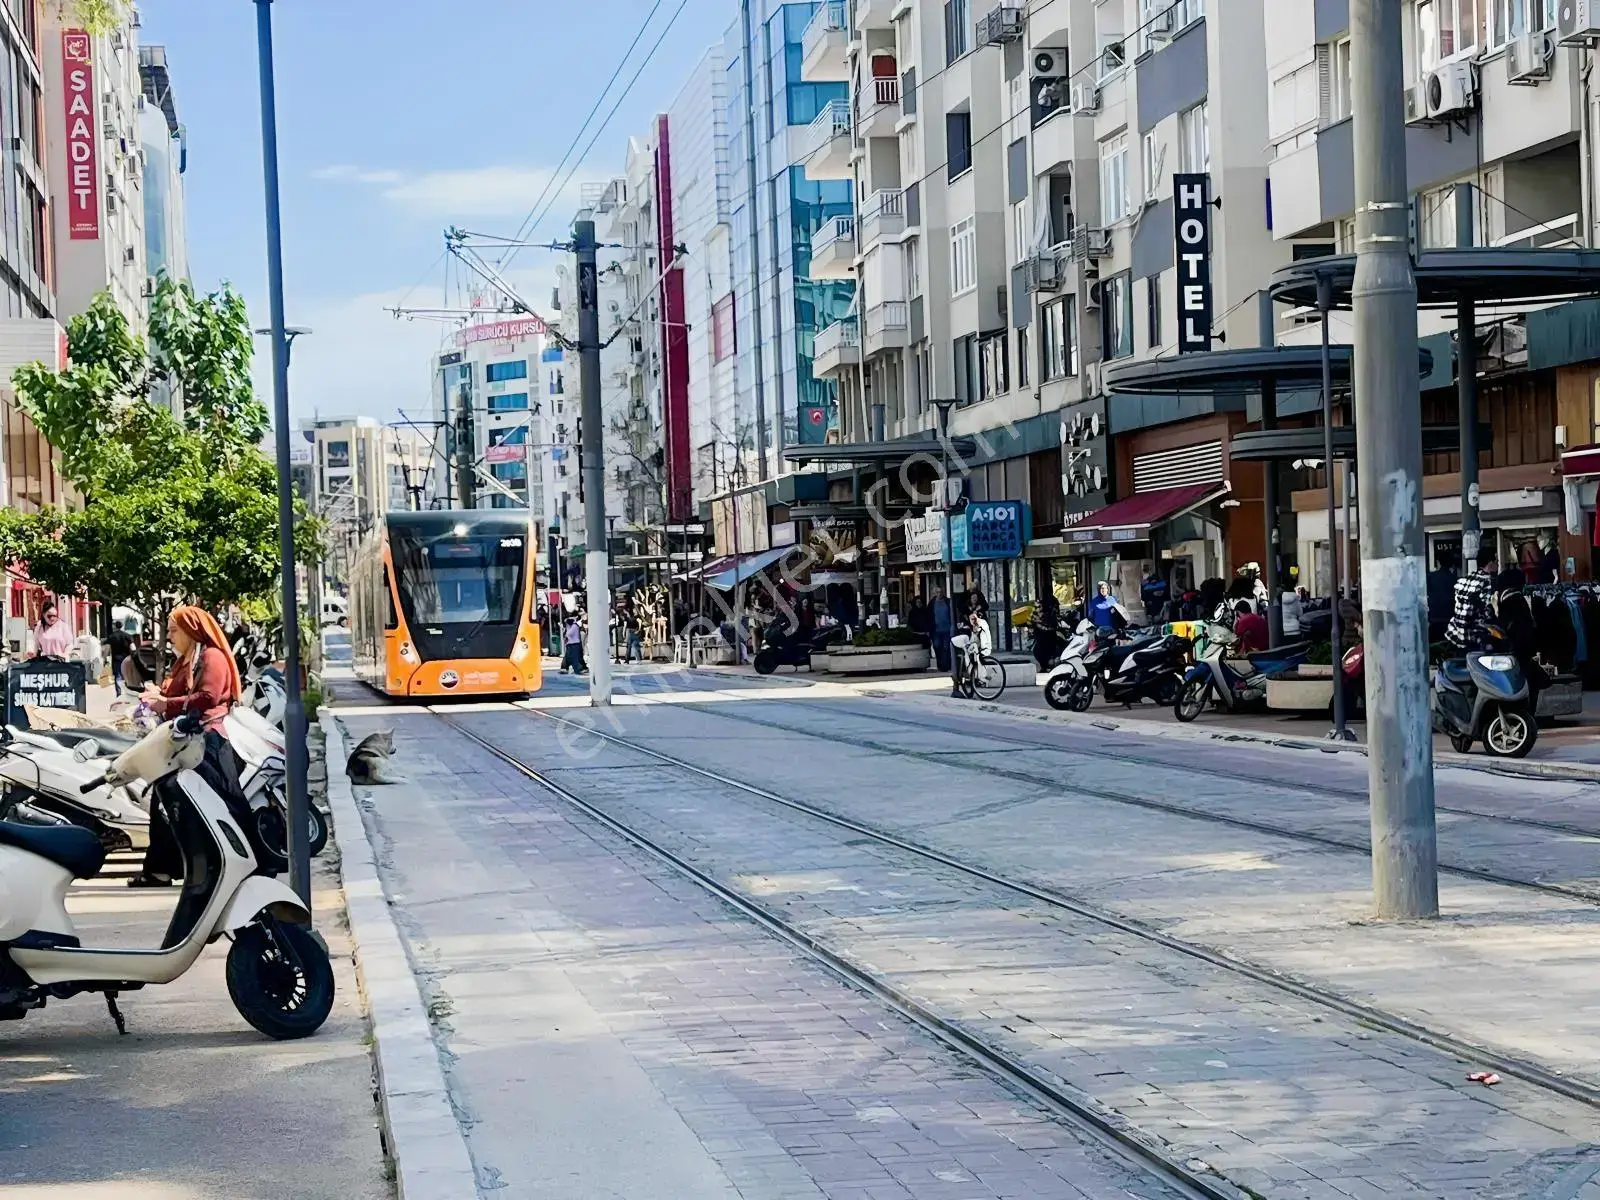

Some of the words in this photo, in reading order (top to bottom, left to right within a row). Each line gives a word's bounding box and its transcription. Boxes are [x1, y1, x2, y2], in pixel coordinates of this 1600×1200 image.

[69, 70, 92, 210] SAADET
[1179, 184, 1205, 343] HOTEL
[19, 673, 70, 691] MEŞHUR
[39, 688, 76, 707] KATMERİ
